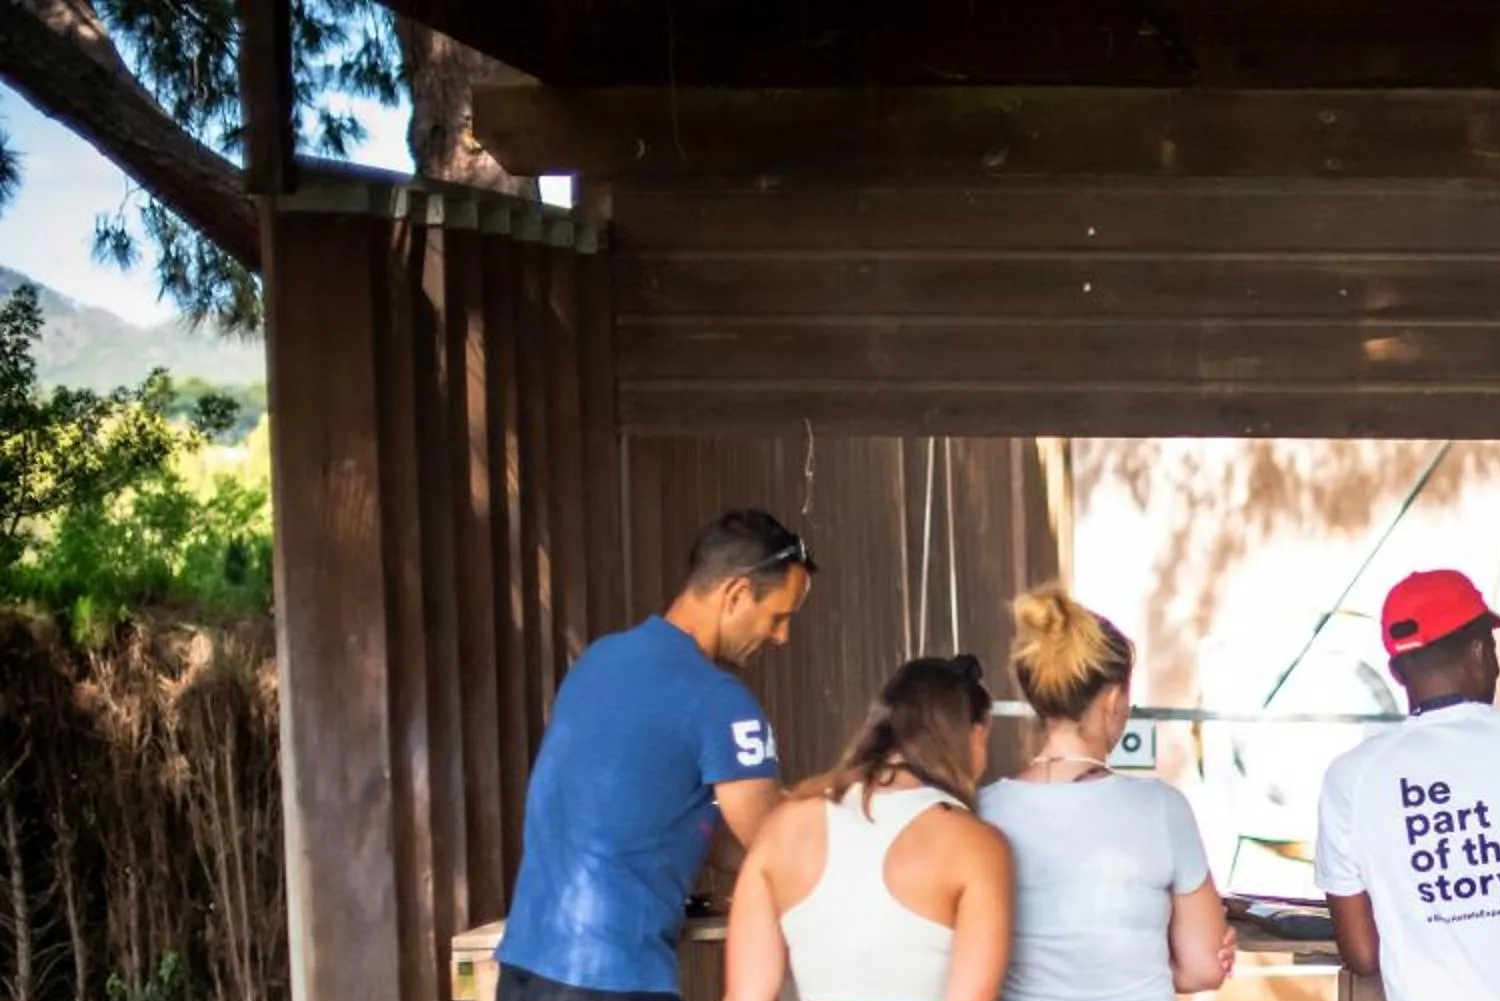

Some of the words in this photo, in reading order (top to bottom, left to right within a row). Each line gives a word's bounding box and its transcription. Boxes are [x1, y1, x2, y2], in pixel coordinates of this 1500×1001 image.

[731, 719, 777, 766] 5
[1400, 777, 1451, 808] be
[1405, 800, 1492, 845] part
[1410, 838, 1451, 873] of
